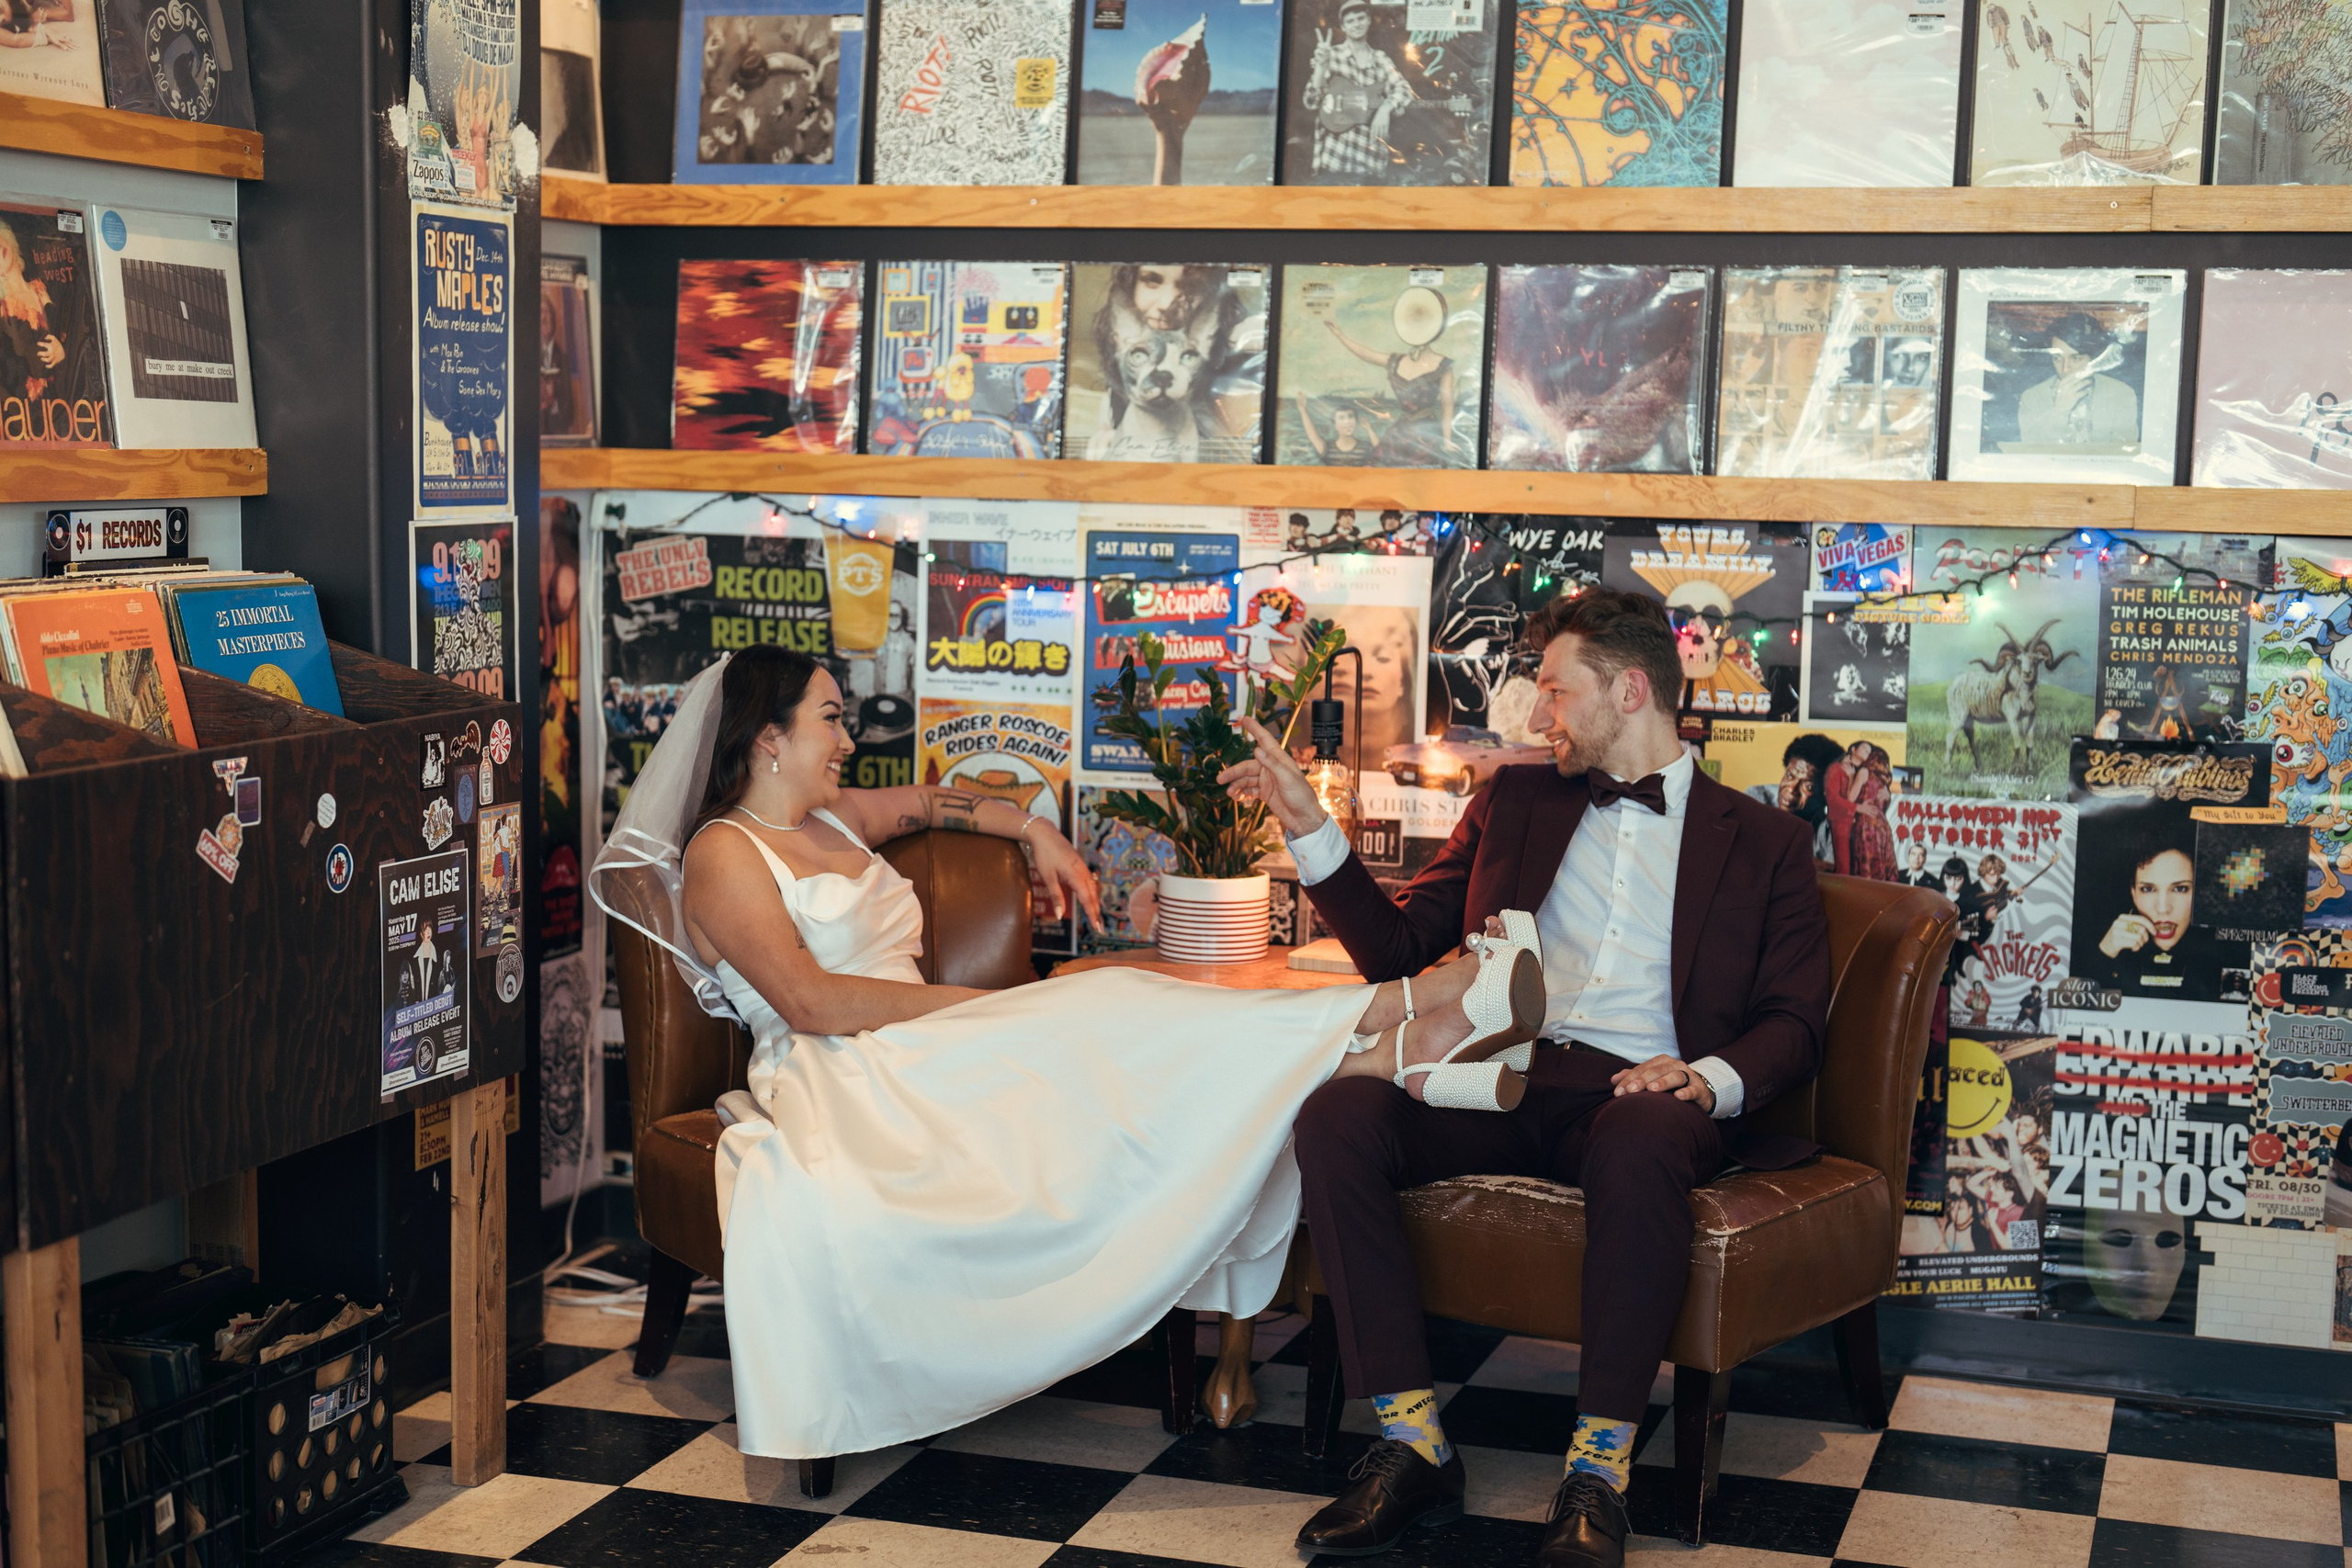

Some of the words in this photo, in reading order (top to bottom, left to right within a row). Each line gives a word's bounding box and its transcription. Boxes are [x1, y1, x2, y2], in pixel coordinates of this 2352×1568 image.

[1422, 46, 1445, 76] 2
[899, 34, 952, 115] RIOT!
[413, 160, 445, 184] Zappos
[425, 229, 475, 273] RUSTY
[436, 270, 503, 316] MAPLES
[424, 306, 449, 330] Album
[451, 313, 480, 332] release
[481, 311, 505, 333] show!
[1778, 322, 1815, 333] FILTHY
[1874, 322, 1935, 334] BASTARDS
[147, 359, 163, 372] bury
[165, 363, 175, 372] me
[178, 363, 185, 372] at
[187, 364, 203, 374] make
[205, 365, 215, 375] out
[217, 366, 233, 377] creek
[76, 519, 92, 554] $1
[102, 519, 163, 550] RECORDS
[1509, 527, 1555, 551] WYE
[1563, 528, 1604, 551] OAK
[1657, 523, 1751, 551] YOURS,
[618, 551, 654, 574] THE
[660, 537, 707, 564] UNLV
[1095, 540, 1118, 556] SAT
[1120, 541, 1148, 557] JULY
[1149, 543, 1175, 558] 6TH
[1817, 540, 1855, 569] VIVA
[1855, 533, 1906, 567] VEGAS
[619, 560, 711, 600] REBELS
[716, 565, 824, 604] RECORD
[837, 564, 884, 584] PTS
[928, 571, 957, 587] SUN
[1133, 581, 1232, 626] Escapers
[2111, 587, 2146, 604] THE
[2152, 589, 2242, 605] RIFLEMAN
[216, 609, 231, 628] 25
[232, 604, 295, 627] IMMORTAL
[1012, 608, 1074, 620] ANNIVERSARY
[1012, 617, 1036, 628] TOUR
[1855, 613, 1923, 625] PICTURE
[2111, 605, 2139, 619] TIM
[2143, 606, 2240, 623] HOLEHOUSE
[711, 615, 827, 654] RELEASE
[2110, 621, 2163, 636] GREG
[2175, 623, 2239, 637] REKUS
[42, 645, 60, 655] Piano
[60, 642, 77, 654] Music
[217, 631, 307, 658] MASTERPIECES
[2109, 636, 2162, 650] TRASH
[2166, 638, 2238, 653] ANIMALS
[2110, 650, 2155, 663] CHRIS
[2163, 652, 2238, 665] MENDOZA
[1690, 689, 1772, 714] ARCS
[924, 714, 993, 747] RANGER
[998, 714, 1070, 745] ROSCOE
[1713, 726, 1755, 735] CHARLES
[1713, 734, 1755, 742] BRADLEY
[945, 734, 999, 757] RIDES
[1003, 736, 1069, 766] AGAIN!
[857, 755, 910, 788] 6TH
[1369, 795, 1430, 814] CHRIS
[1897, 801, 2017, 828] HALLOWEEN
[2022, 807, 2062, 829] HOP
[429, 827, 452, 848] COFFEE
[1896, 826, 2007, 852] OCTOBER
[219, 852, 237, 874] OFF
[390, 875, 420, 905] CAM
[424, 867, 459, 898] ELISE
[388, 922, 405, 937] MAY
[405, 913, 418, 932] 17
[388, 936, 400, 946] 2025
[1973, 939, 2062, 983] JACKETS
[2063, 977, 2097, 995] stay
[2291, 988, 2330, 997] PRESENTS
[396, 1001, 434, 1025] SELF-TITLED
[435, 994, 453, 1010] DEBUT
[2051, 991, 2121, 1010] ICONIC
[390, 1023, 413, 1043] ALBUM
[413, 1013, 440, 1034] RELEASE
[441, 1006, 461, 1023] EVENT
[2055, 1025, 2256, 1078] EDWARD
[2149, 1100, 2188, 1121] THE
[2051, 1111, 2250, 1170] MAGNETIC
[420, 1151, 433, 1166] FEB
[2046, 1156, 2248, 1221] ZEROS
[2247, 1179, 2274, 1190] FRI.
[2278, 1181, 2322, 1195] 08/30
[1918, 1257, 1965, 1266] ELEVATED
[1927, 1278, 1984, 1294] AERIE
[1985, 1276, 2037, 1292] HALL
[1582, 1450, 1613, 1463] FOR
